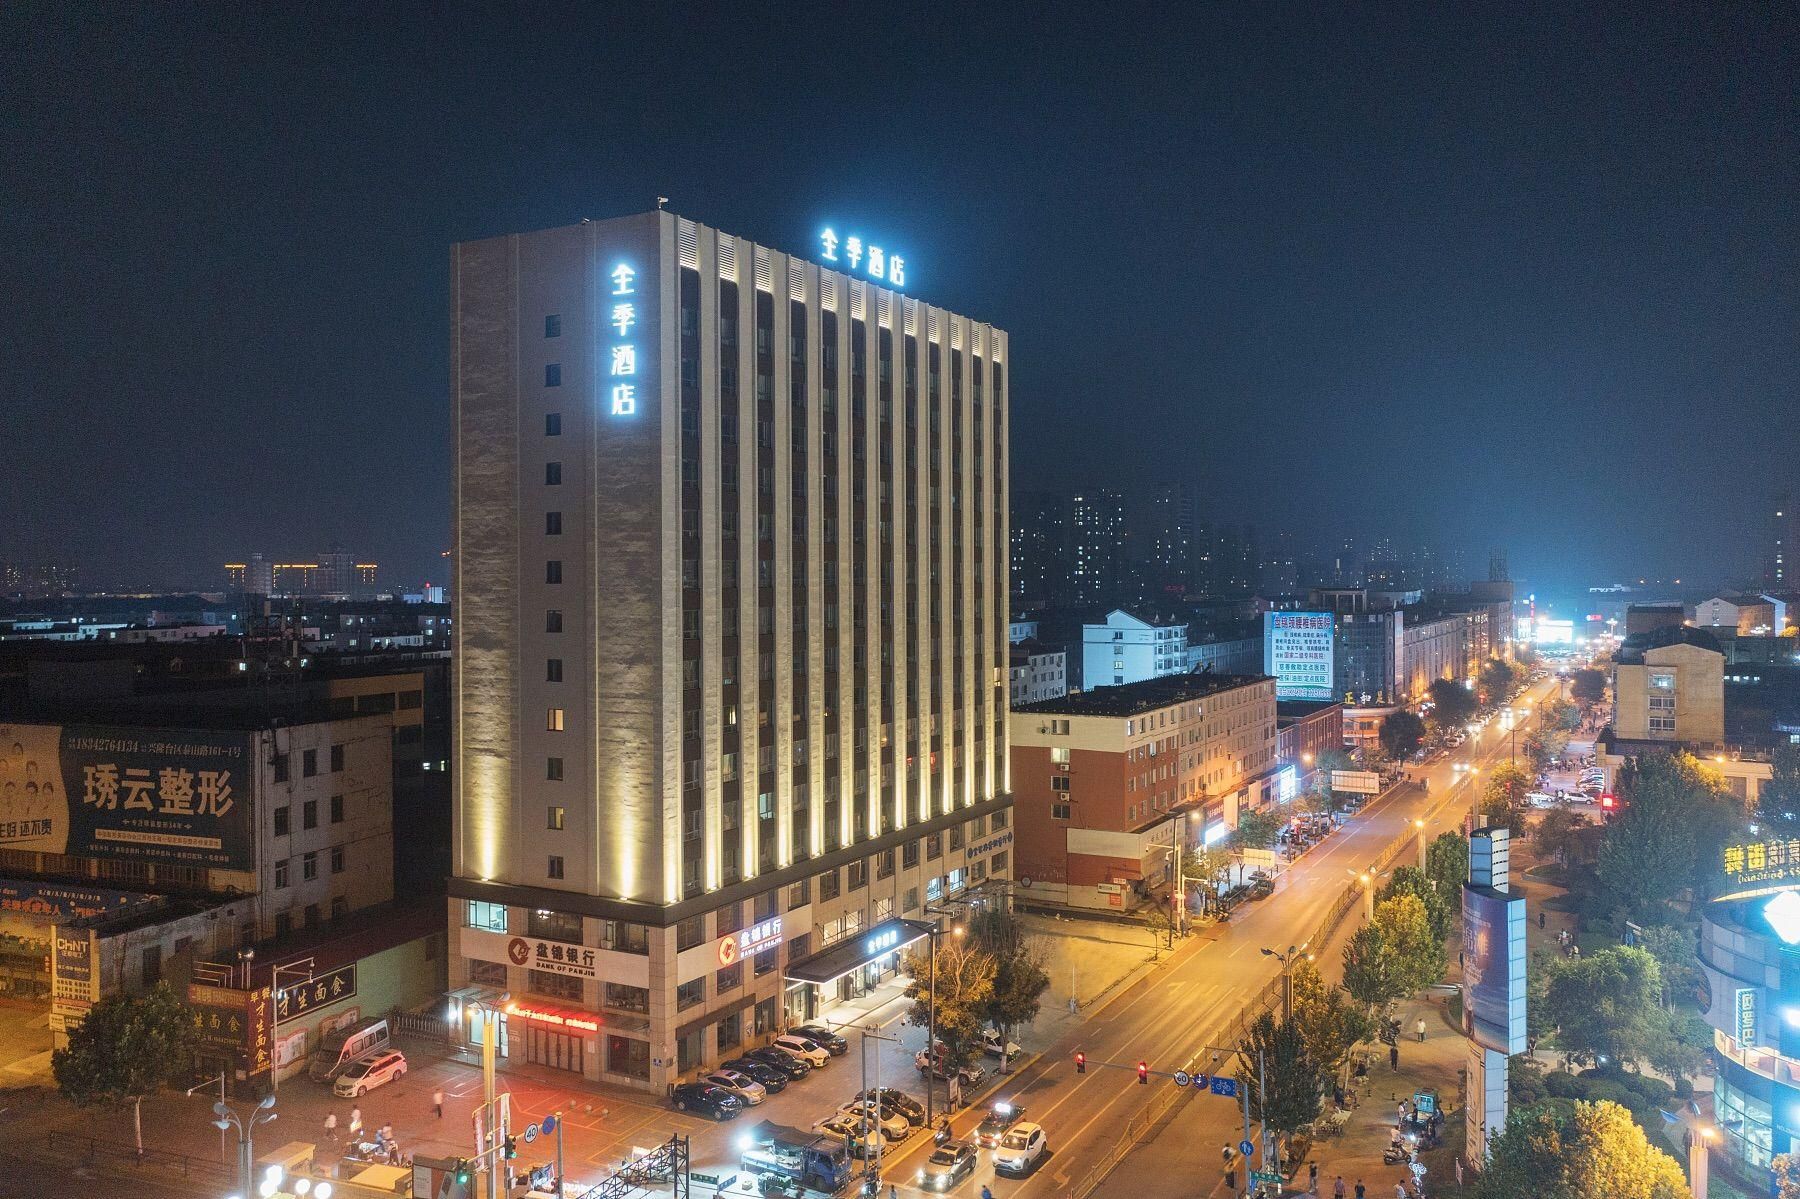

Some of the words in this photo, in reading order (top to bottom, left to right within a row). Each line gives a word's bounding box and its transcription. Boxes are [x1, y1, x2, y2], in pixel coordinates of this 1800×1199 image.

[820, 228, 905, 287] 全季酒店
[611, 263, 636, 416] 全季酒店
[83, 763, 234, 818] 琇云整形
[536, 942, 596, 966] 盘锦银行
[536, 962, 555, 970] BANK
[569, 967, 596, 977] PANJIN
[1177, 1074, 1187, 1083] 60
[526, 1127, 537, 1140] 40
